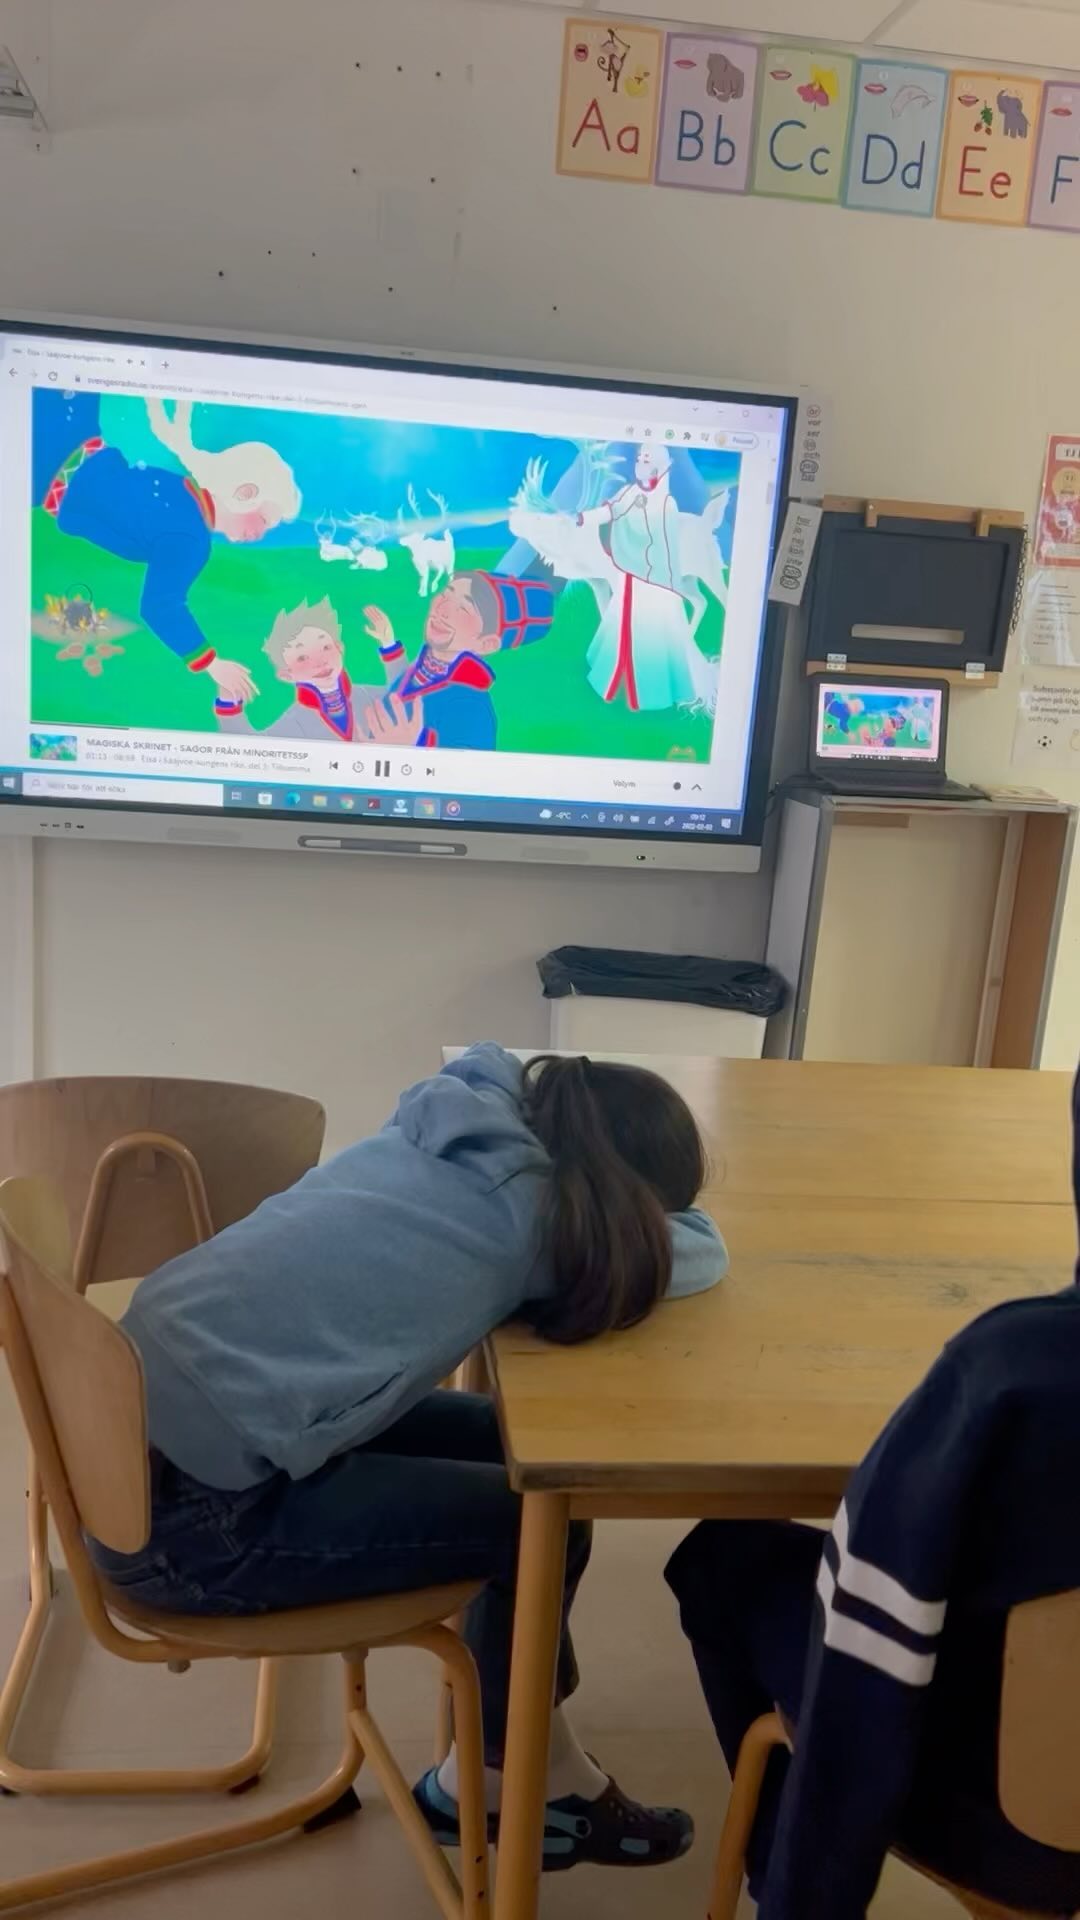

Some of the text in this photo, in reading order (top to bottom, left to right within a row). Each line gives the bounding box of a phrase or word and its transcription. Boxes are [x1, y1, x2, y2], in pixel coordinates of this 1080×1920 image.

[571, 98, 640, 155] Aa
[676, 109, 736, 167] Bb
[769, 119, 831, 176] Cc
[861, 133, 926, 190] Dd
[958, 145, 1012, 199] Ee
[1050, 154, 1080, 204] F
[86, 738, 130, 749] MAGISKA
[133, 741, 172, 751] SKRINET
[179, 744, 213, 754] SAGOR
[215, 745, 241, 756] FRÅN
[243, 748, 309, 760] MINORITETSSP
[613, 779, 636, 788] Volym
